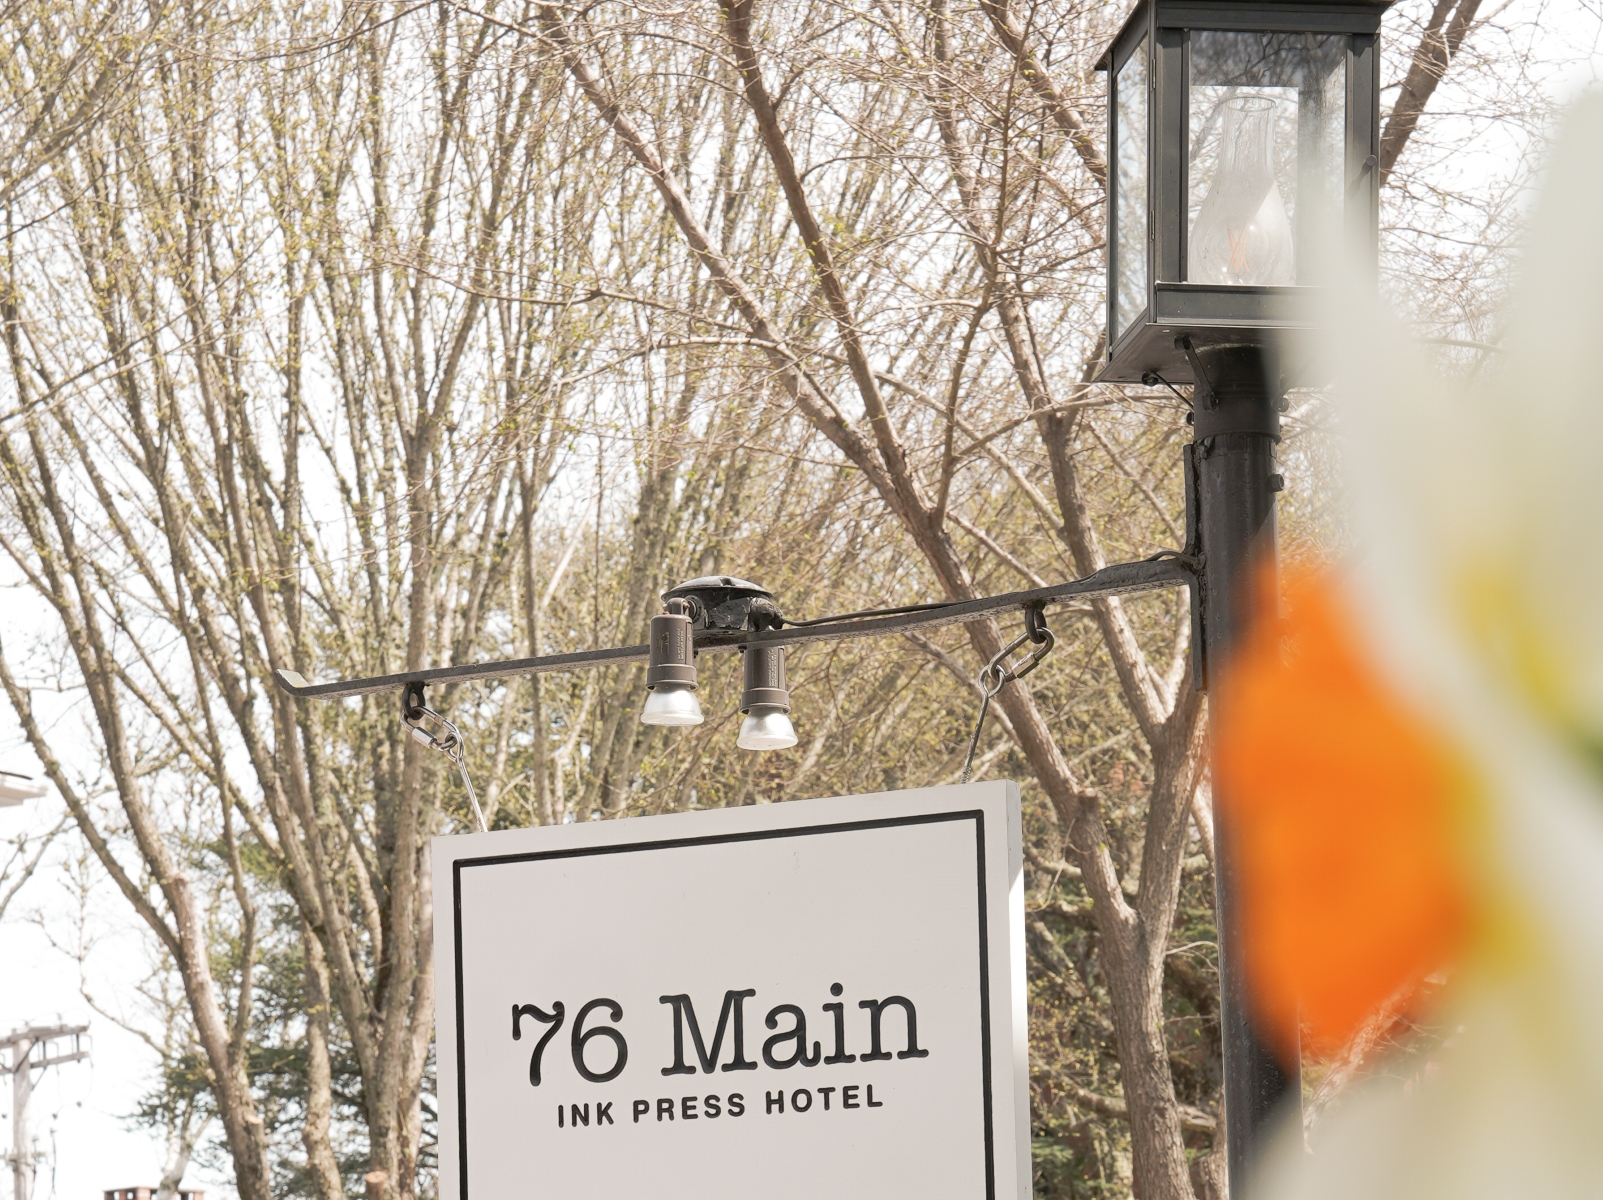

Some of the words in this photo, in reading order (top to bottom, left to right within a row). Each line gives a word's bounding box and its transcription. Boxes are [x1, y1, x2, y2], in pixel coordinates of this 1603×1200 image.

[511, 997, 629, 1087] 76
[658, 982, 930, 1077] Main
[557, 1101, 615, 1129] INK
[632, 1092, 746, 1124] PRESS
[765, 1083, 884, 1115] HOTEL
